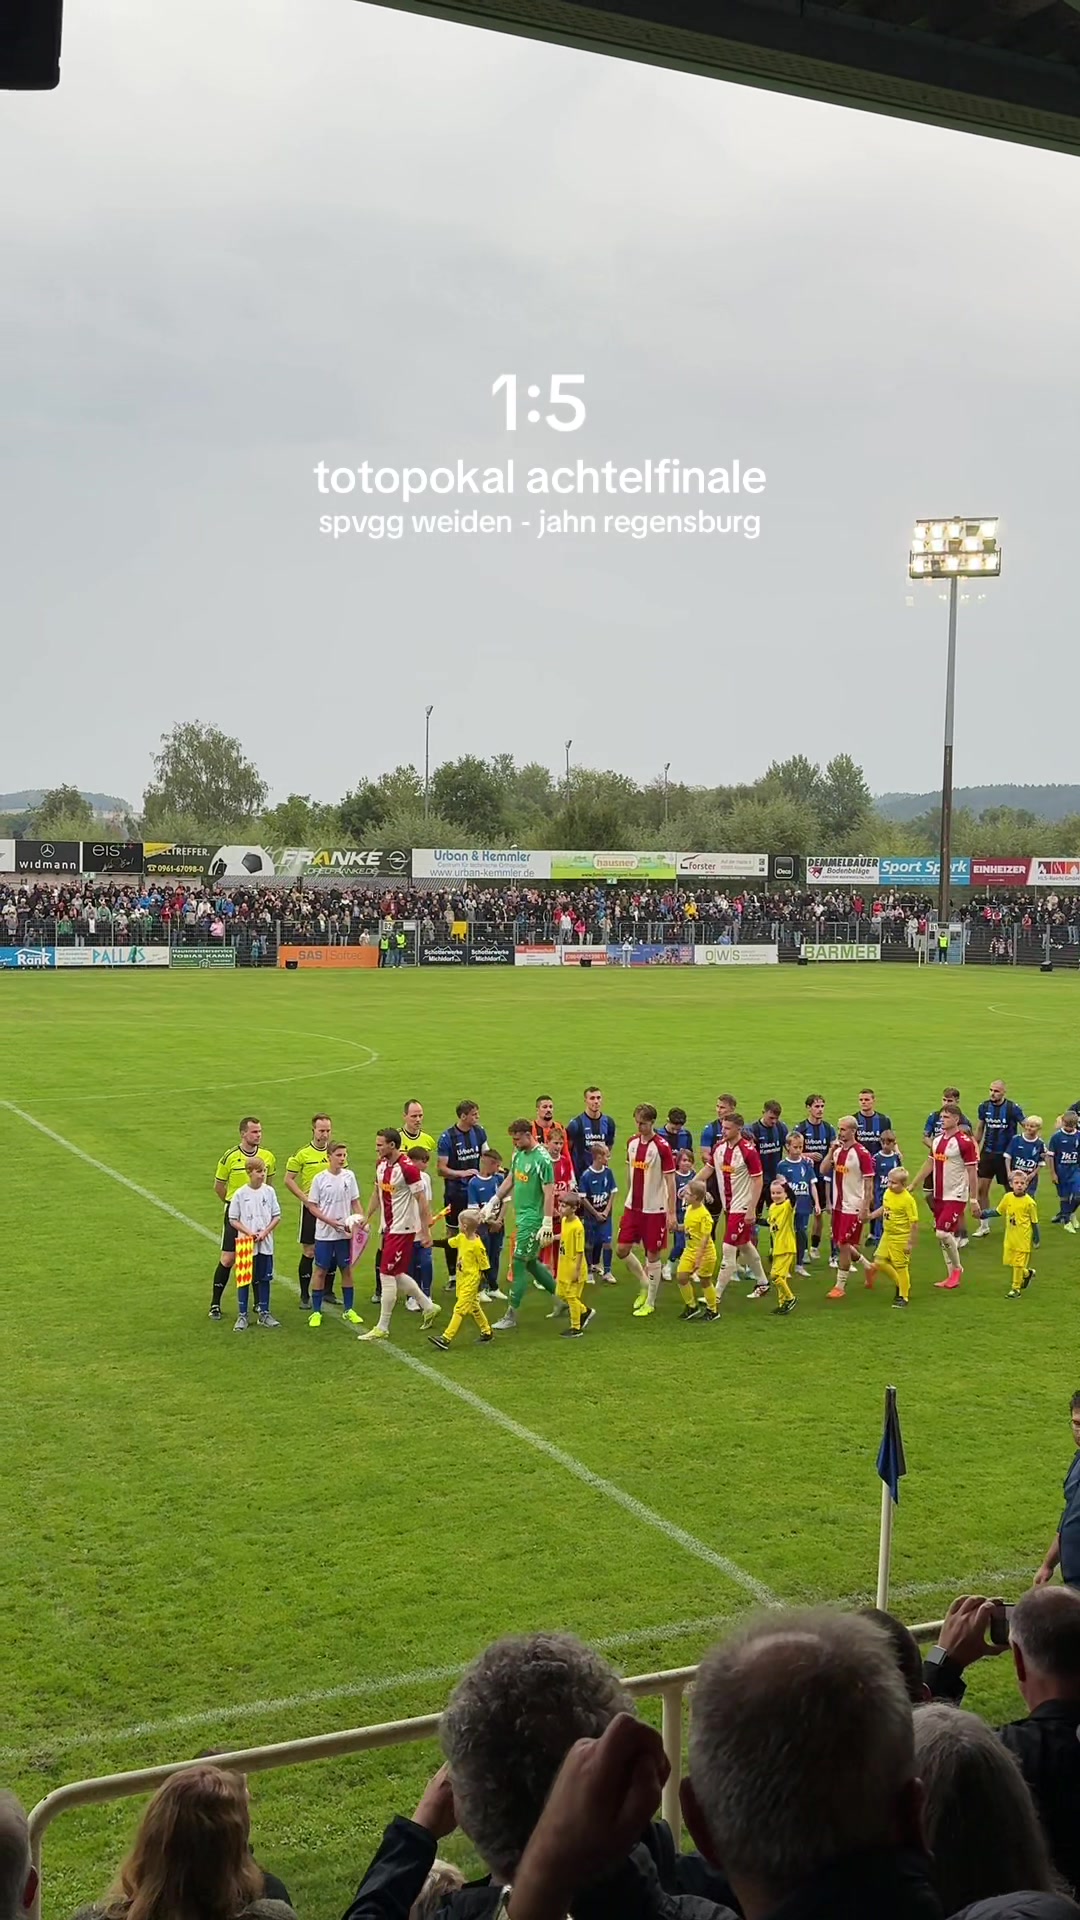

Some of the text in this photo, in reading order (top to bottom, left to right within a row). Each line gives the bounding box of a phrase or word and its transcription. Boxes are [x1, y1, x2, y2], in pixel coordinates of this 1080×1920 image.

[280, 851, 383, 866] FRANKE
[434, 850, 531, 862] Urban & Kemmler
[19, 860, 77, 870] widmann
[596, 859, 635, 868] hausner
[689, 862, 716, 871] forster
[808, 858, 879, 867] DEMMELBAUER
[881, 860, 967, 875] Sport Sprk
[429, 868, 535, 878] www.urban-kemmler.de
[827, 867, 870, 876] Bodenbeläge
[973, 865, 1026, 874] EINHEIZER
[17, 950, 51, 965] Rank
[298, 951, 323, 960] SAS
[804, 946, 877, 959] BARMER
